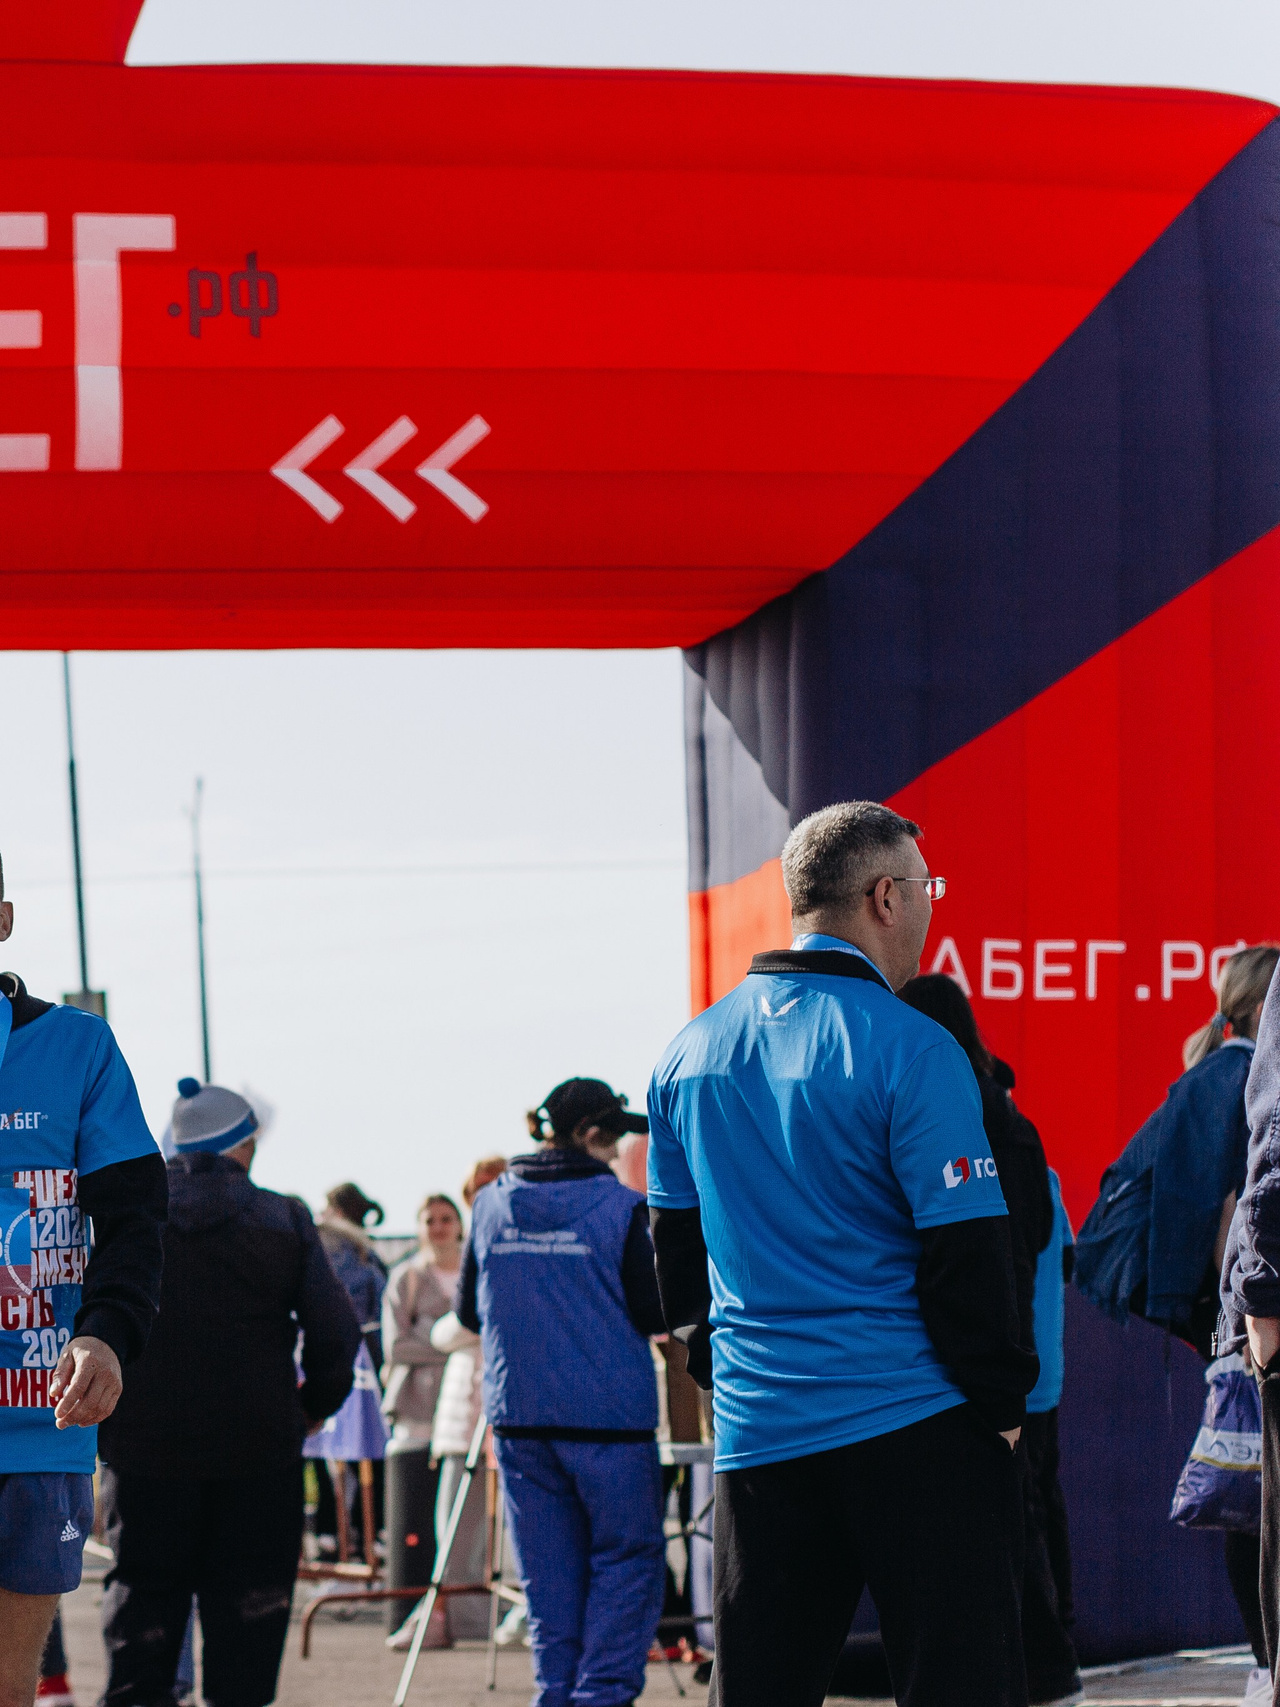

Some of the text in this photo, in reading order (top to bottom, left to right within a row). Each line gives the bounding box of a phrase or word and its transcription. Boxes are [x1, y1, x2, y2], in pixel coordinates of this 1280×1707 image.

[925, 935, 1248, 1000] АБЕГ.Р
[38, 1207, 86, 1249] 202
[21, 1328, 71, 1368] 202
